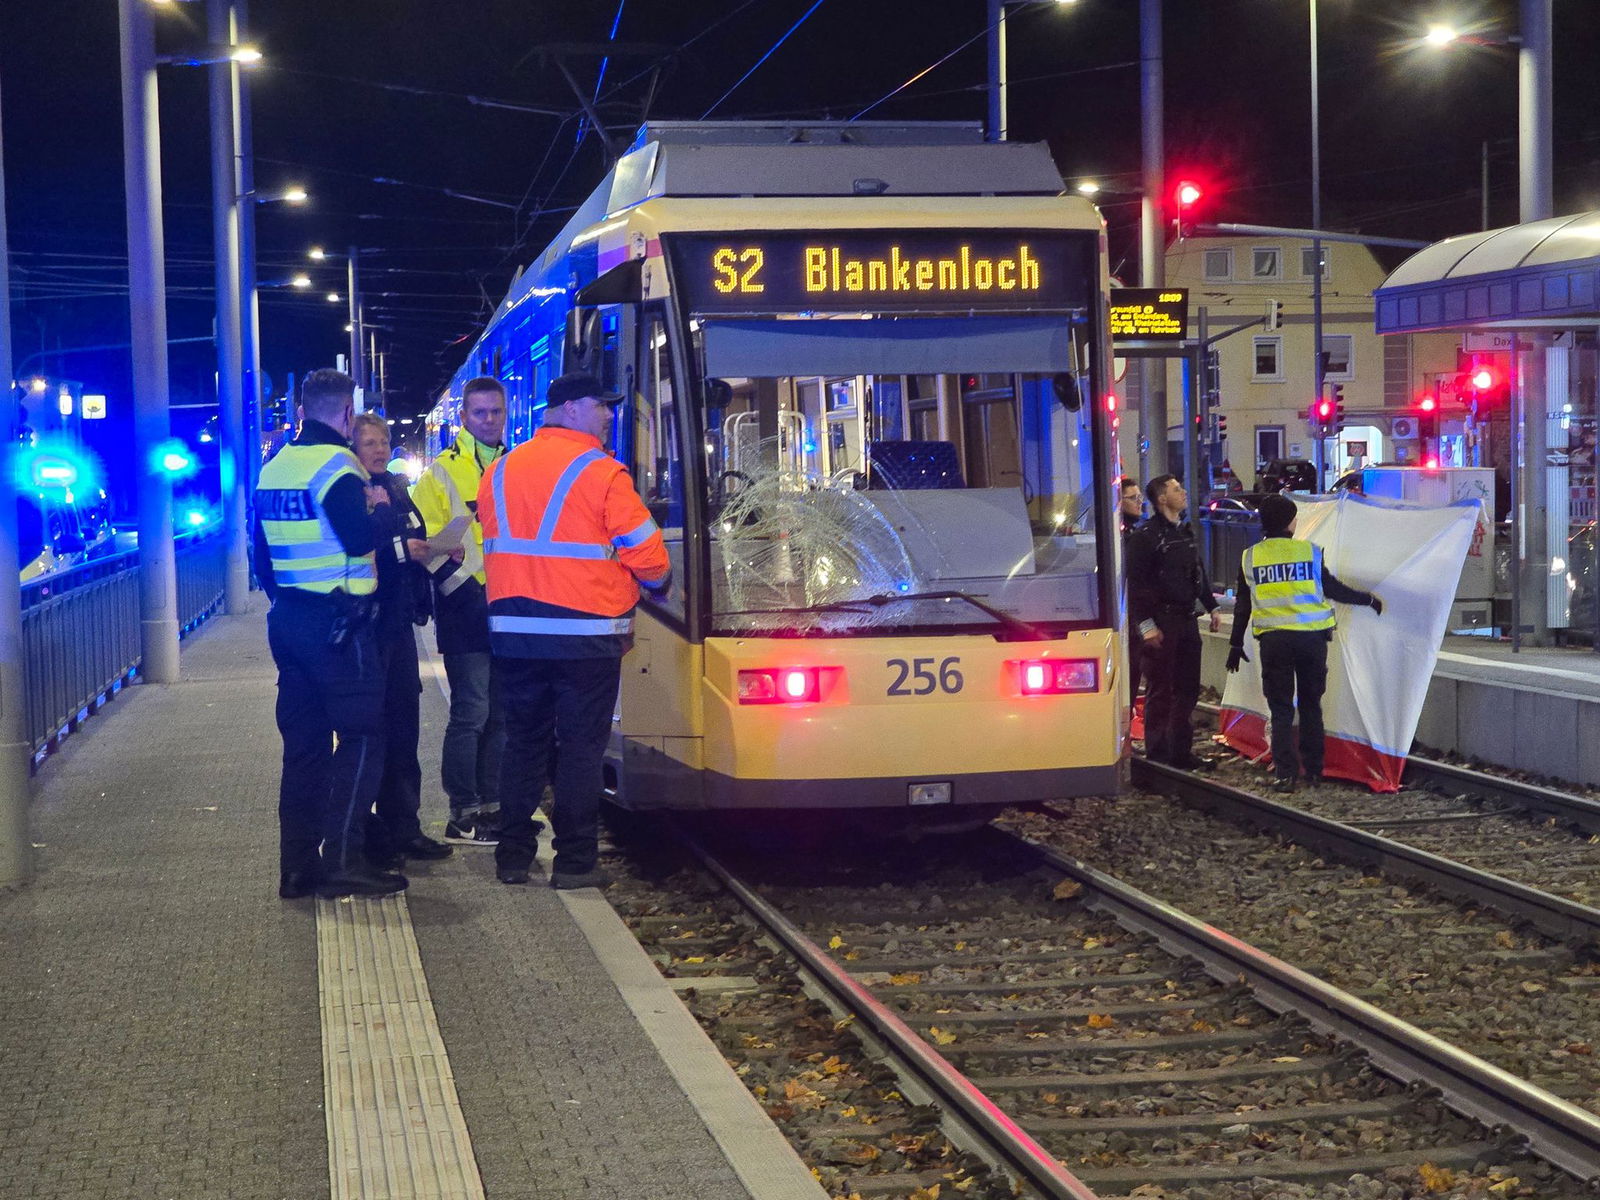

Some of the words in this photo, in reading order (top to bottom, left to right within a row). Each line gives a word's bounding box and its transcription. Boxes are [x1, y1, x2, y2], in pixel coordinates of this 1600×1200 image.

[714, 248, 764, 293] S2
[805, 246, 1039, 292] Blankenloch
[1494, 336, 1513, 346] Dax
[1258, 562, 1309, 584] POLIZEI
[886, 656, 964, 697] 256
